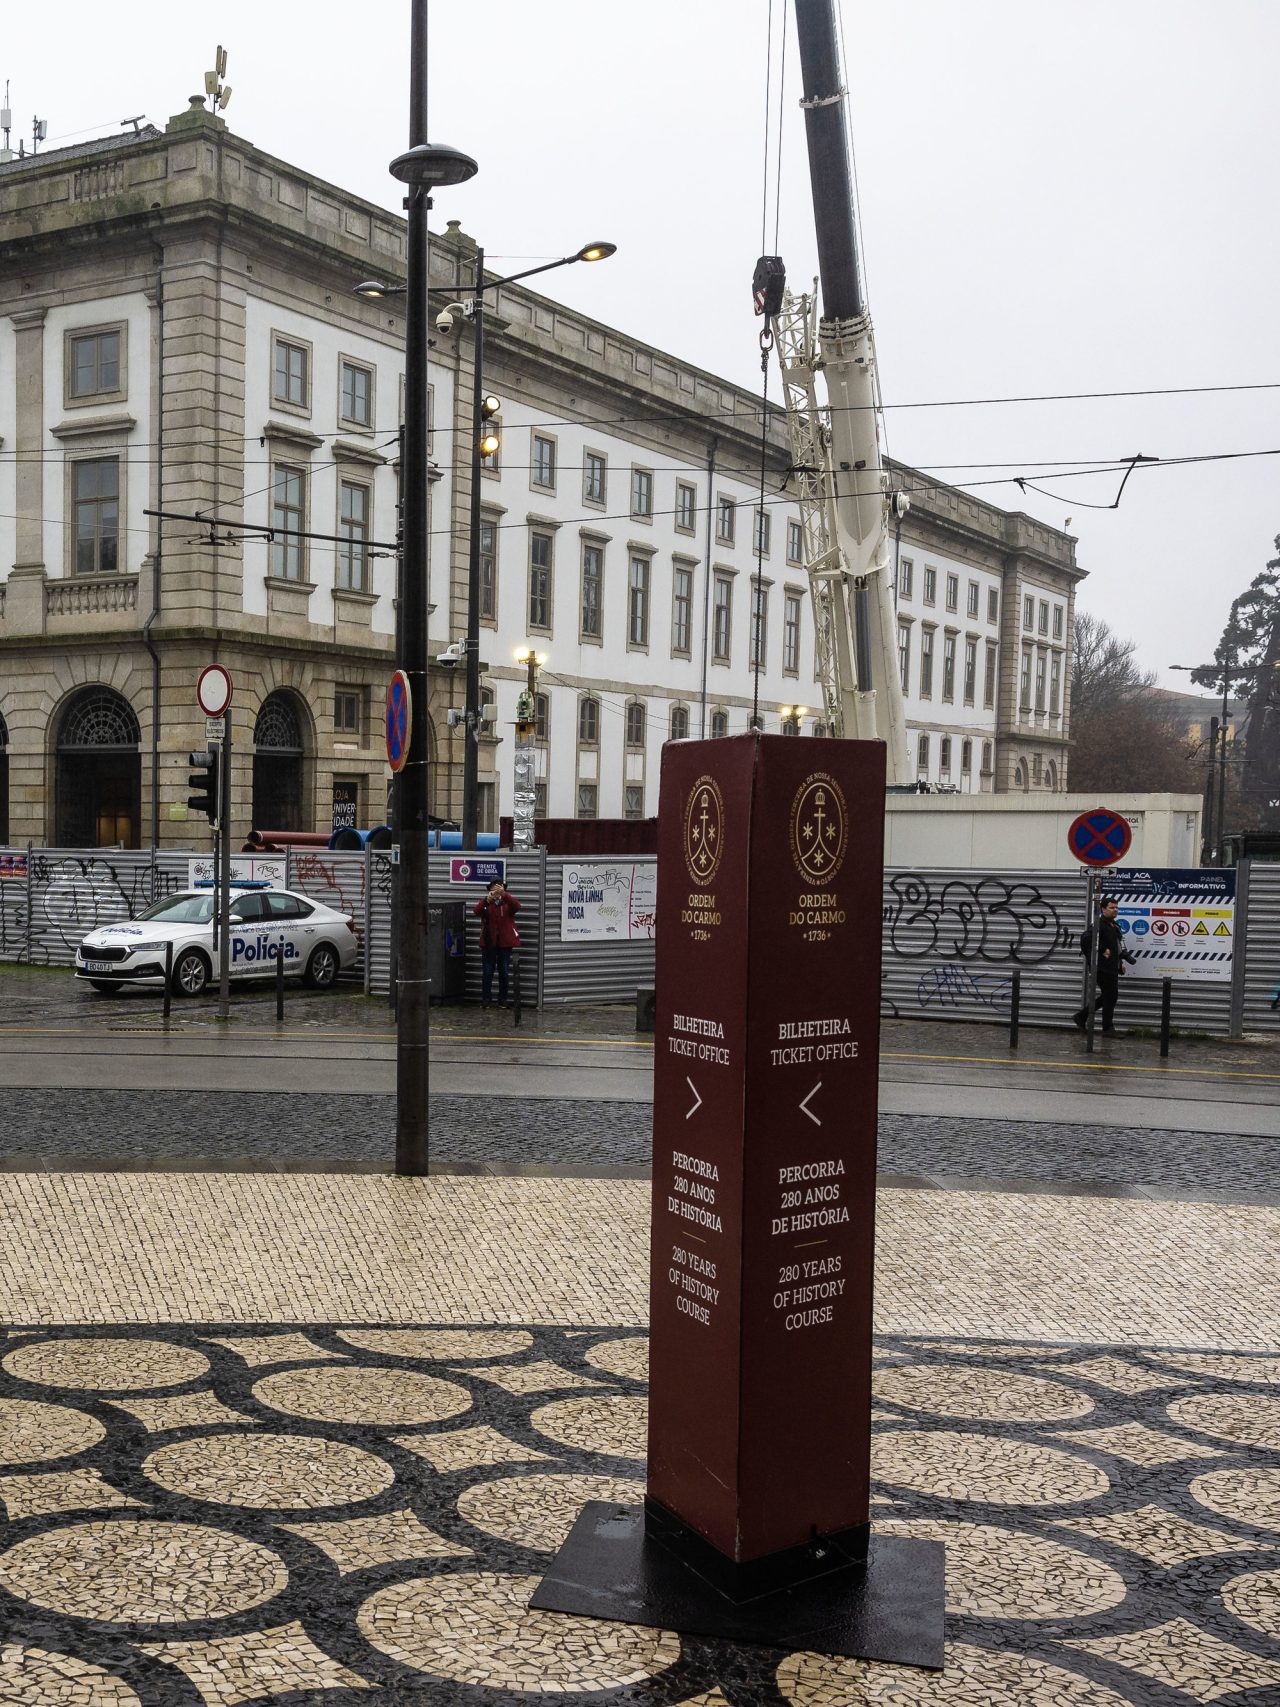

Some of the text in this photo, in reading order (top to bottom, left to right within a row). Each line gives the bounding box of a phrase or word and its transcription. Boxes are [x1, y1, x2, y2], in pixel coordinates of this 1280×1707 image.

[333, 790, 348, 800] OJA
[791, 782, 806, 816] TERCEIRA
[806, 775, 814, 784] DE
[814, 772, 830, 780] NOSSA
[332, 816, 354, 826] IDADE
[568, 890, 603, 903] NOVA LINHA
[689, 895, 715, 908] ORDEM
[799, 894, 836, 908] ORDEM
[568, 906, 584, 920] ROSA
[682, 911, 720, 925] DO CARMO
[789, 911, 846, 925] DO CARMO
[673, 1014, 724, 1039] BILHETEIRA
[779, 1018, 851, 1040] BILHETEIRA
[669, 1037, 730, 1065] TICKET OFFICE
[771, 1042, 858, 1066] TICKET OFFICE
[673, 1151, 719, 1182] PERCORRA
[779, 1159, 845, 1184] PERCORRA
[674, 1176, 715, 1204] 280 ANOS
[781, 1184, 840, 1208] 280 ANOS
[668, 1196, 722, 1233] DE HISTÓRIA
[772, 1206, 850, 1235] DE HISTÓRIA
[672, 1246, 716, 1279] 280 YEARS
[779, 1256, 842, 1283] 280 YEARS
[669, 1268, 719, 1305] OF HISTORY
[773, 1278, 846, 1309] OF HISTORY
[676, 1296, 710, 1326] COURSE
[785, 1306, 833, 1331] COURSE
